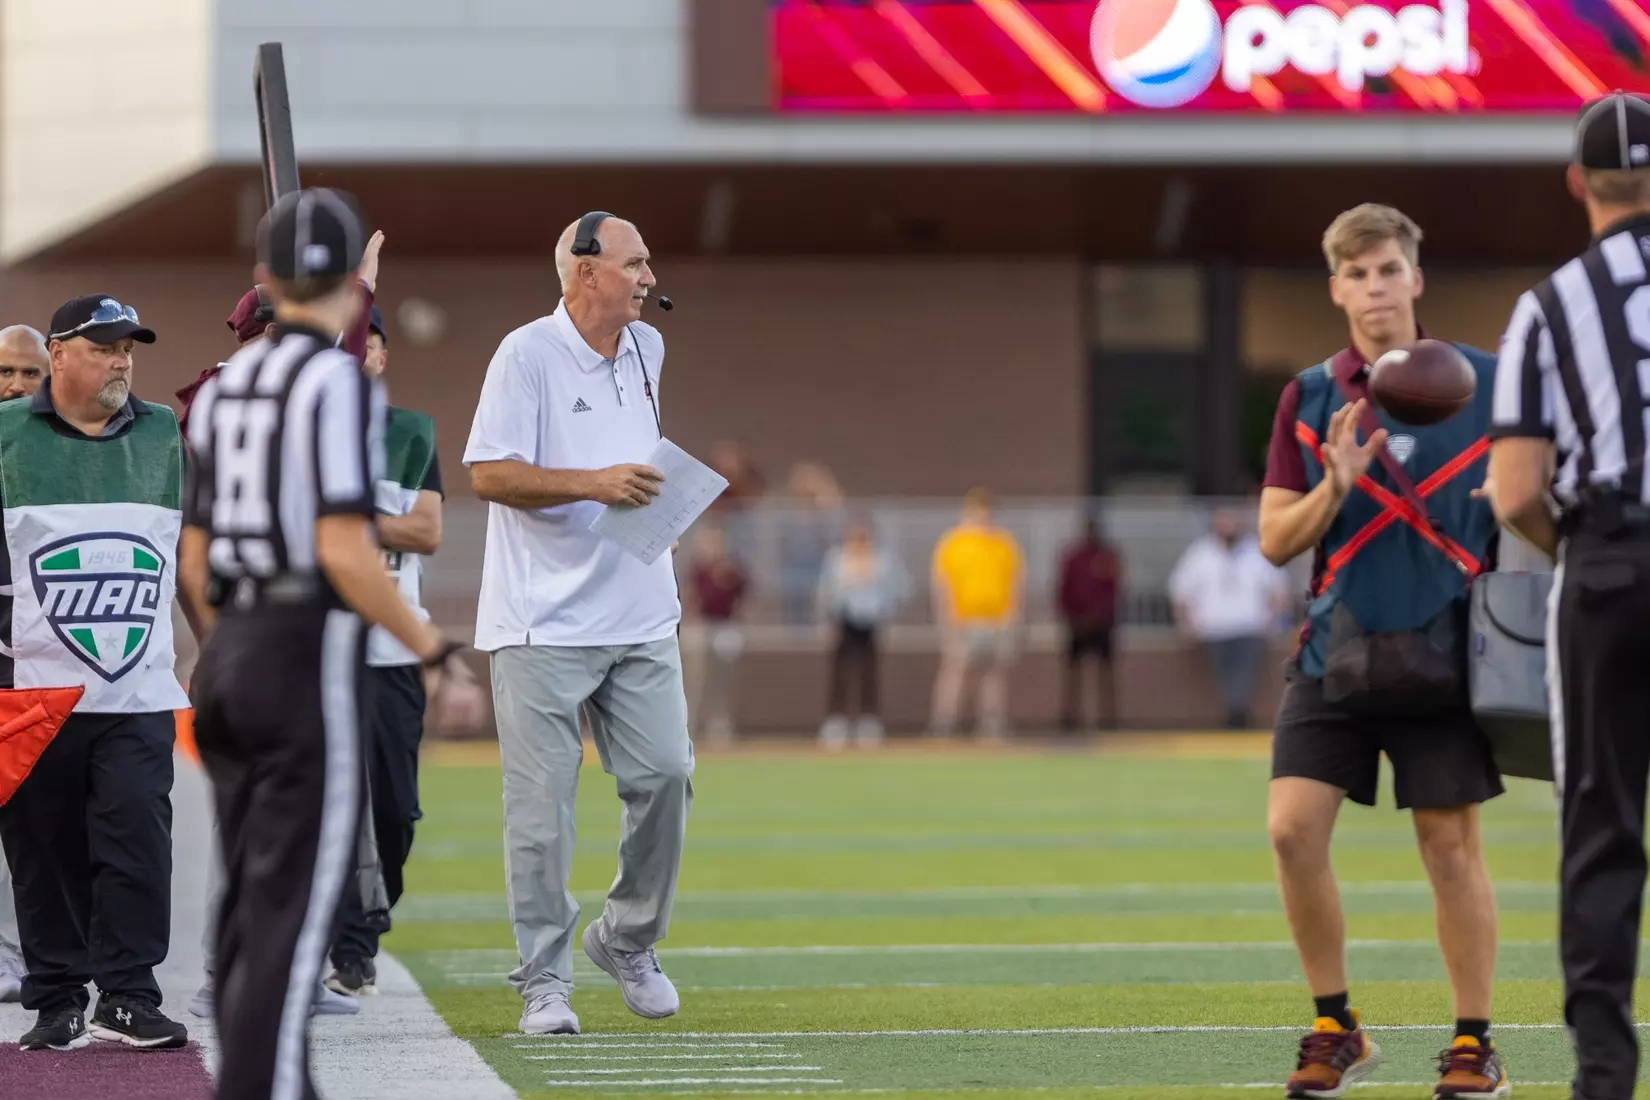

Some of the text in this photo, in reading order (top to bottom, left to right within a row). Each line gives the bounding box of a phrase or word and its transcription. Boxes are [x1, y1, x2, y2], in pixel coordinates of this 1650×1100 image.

[1222, 0, 1470, 92] pepsi
[212, 399, 279, 534] H
[87, 550, 128, 565] 1946
[44, 579, 160, 617] MAC
